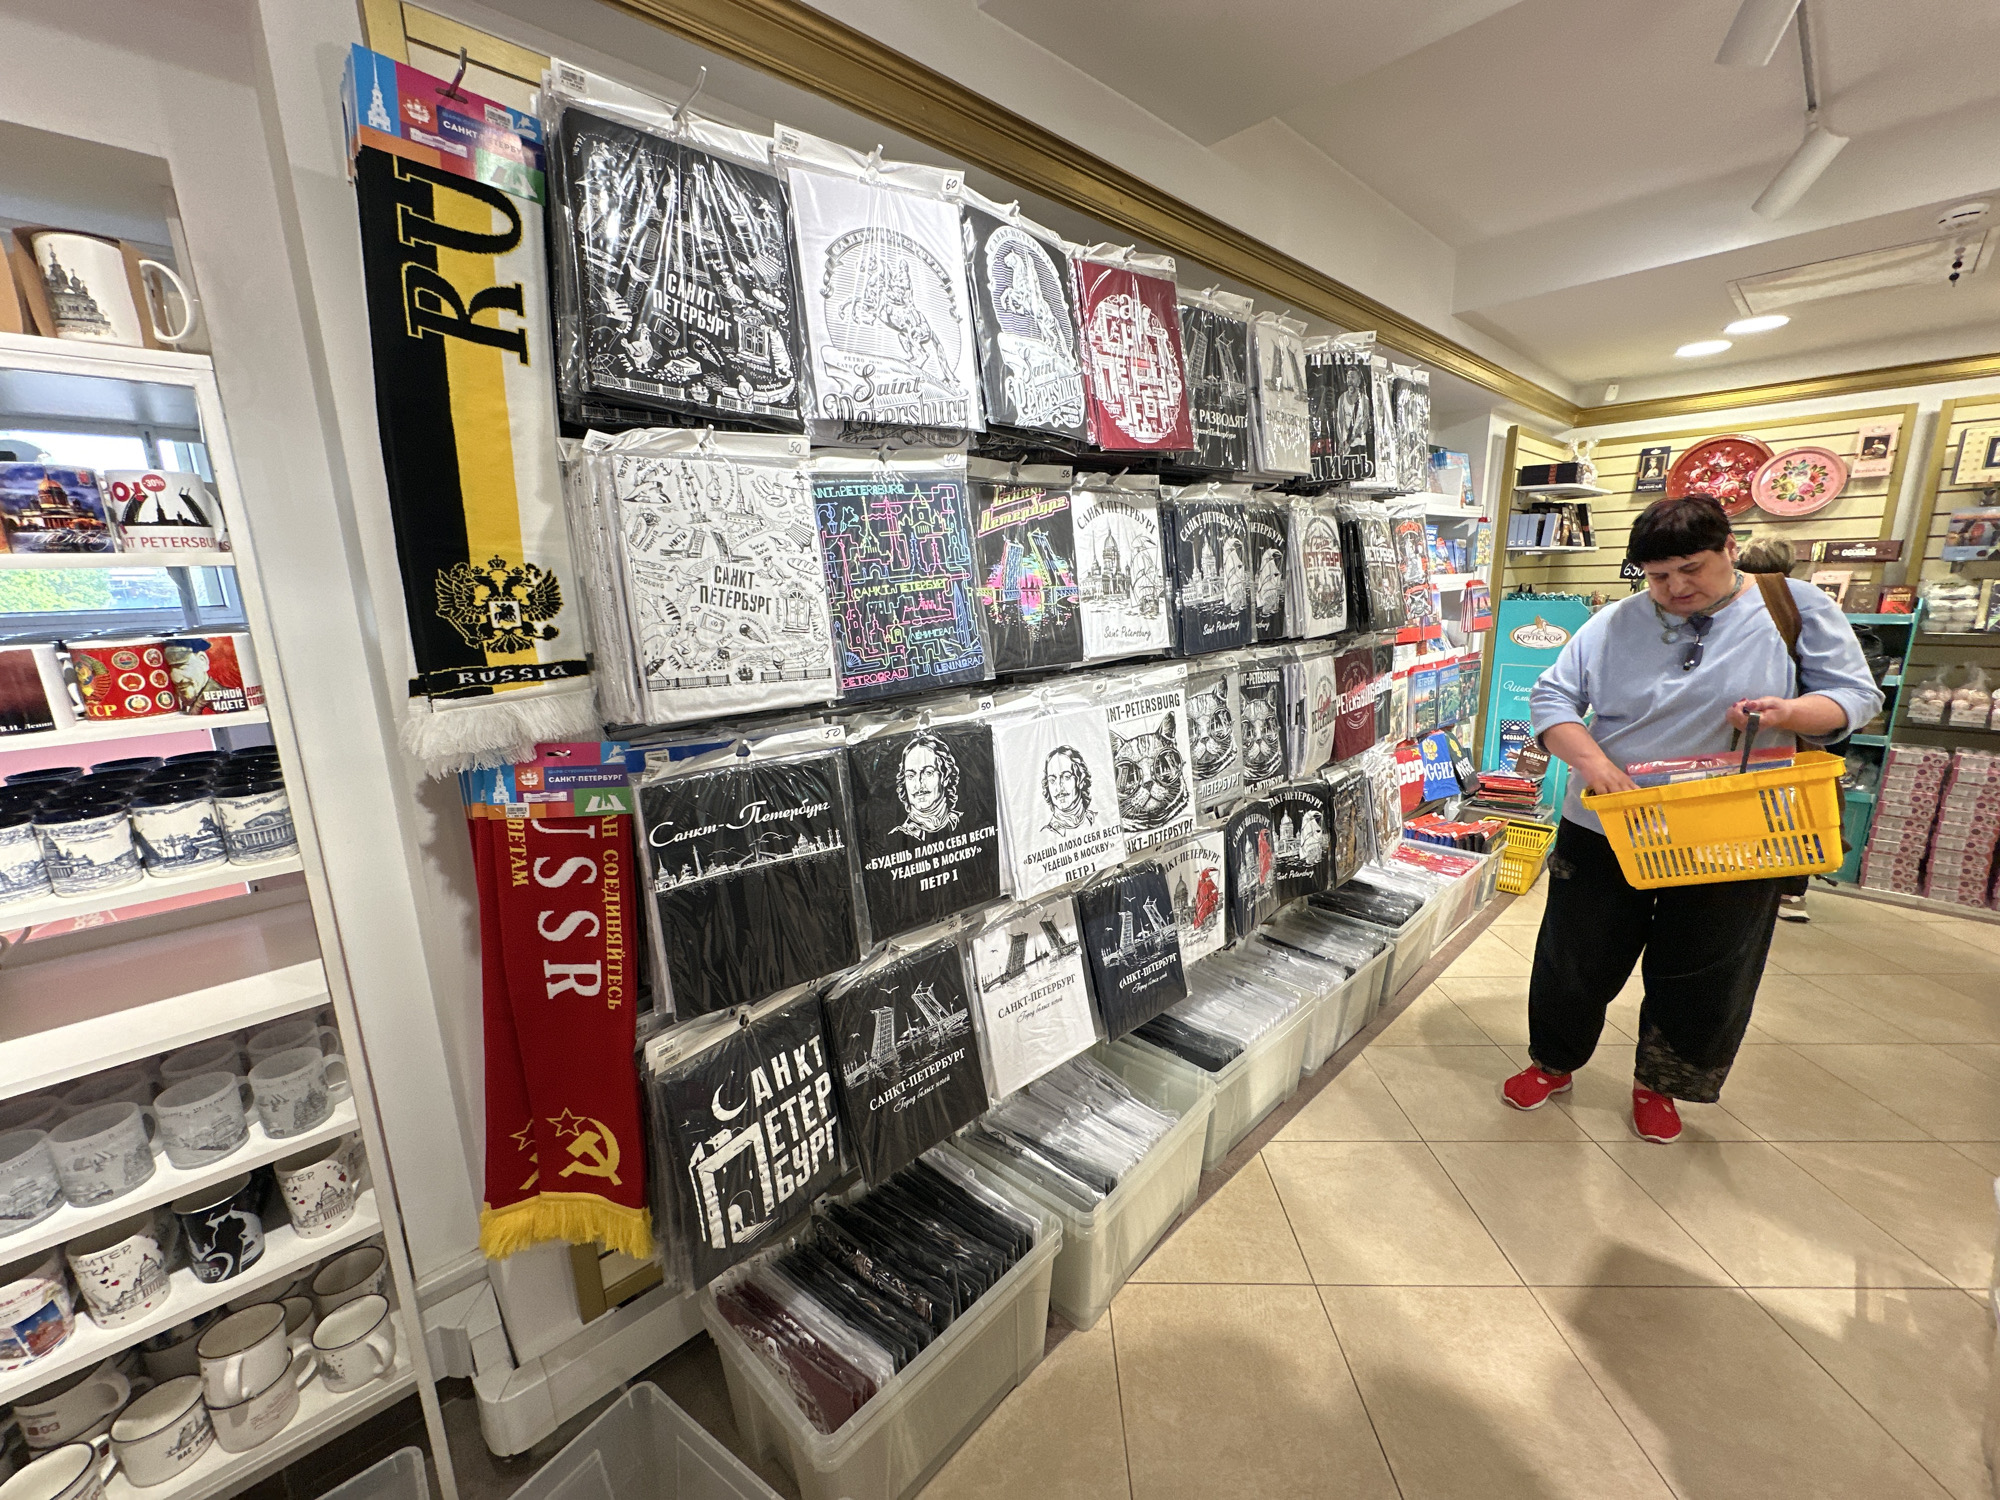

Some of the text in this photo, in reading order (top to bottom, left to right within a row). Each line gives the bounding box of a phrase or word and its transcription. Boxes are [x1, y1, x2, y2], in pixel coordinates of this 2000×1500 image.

[946, 178, 957, 190] 60
[667, 273, 721, 309] САНКТ-
[653, 289, 732, 340] ПЕТЕРБУРГ
[854, 364, 922, 403] Saint
[789, 441, 801, 453] 50
[1061, 469, 1071, 479] 56
[1076, 501, 1158, 535] САНКТ-ПЕТЕРБУРГ
[142, 536, 216, 549] PETERSBU
[1249, 521, 1285, 546] ПЕТЕРБУРГ
[714, 565, 760, 590] САНКТ-
[700, 585, 772, 614] ПЕТЕРБУРГ
[1120, 625, 1152, 640] Petersburg
[457, 664, 569, 685] RUSSIA
[934, 655, 985, 673] LENINGRAD
[1177, 667, 1185, 675] 50
[1239, 668, 1280, 684] INT-PETERSBURG
[842, 668, 909, 690] PETROGRAD
[203, 687, 243, 701] ВЕРНОЙ
[212, 700, 245, 711] ИДЕТЕ
[981, 701, 991, 710] 50
[87, 704, 117, 717] ССР
[1107, 692, 1181, 723] INT-PETERSBURG
[825, 728, 841, 739] 50
[548, 774, 623, 783] САНКТ-ПЕТЕРБУРГ
[1398, 760, 1424, 784] ССР
[1197, 772, 1240, 798] -ПЕТЕРБУРГ
[649, 798, 831, 848] Санкт-Петербург
[865, 825, 999, 871] «БУДЕШЬ ПЛОХО СЕБЯ ВЕСТИ-
[1023, 824, 1122, 866] «БУДЕШЬ ПЛОХО СЕБЯ ВЕСТ
[1126, 819, 1194, 854] НКТ-ПЕТЕРБУРГ
[506, 818, 529, 888] ВЕТАМ
[890, 846, 983, 881] УЕДЕШЬ В МОСКВУ»
[1042, 841, 1115, 874] УЕДЕШЬ В МОСКВУ»
[920, 871, 950, 892] ПЕТР
[1065, 866, 1089, 882] ПЕТР
[602, 849, 625, 1011] СОЕДИНЯЙТЕСЬ
[1118, 953, 1178, 990] САНКТ-ПЕТЕРБУРГ
[998, 973, 1076, 1019] САНКТ-ПЕТЕРБУРГ
[869, 1047, 965, 1111] САНКТ-ПЕТЕРБУРГ
